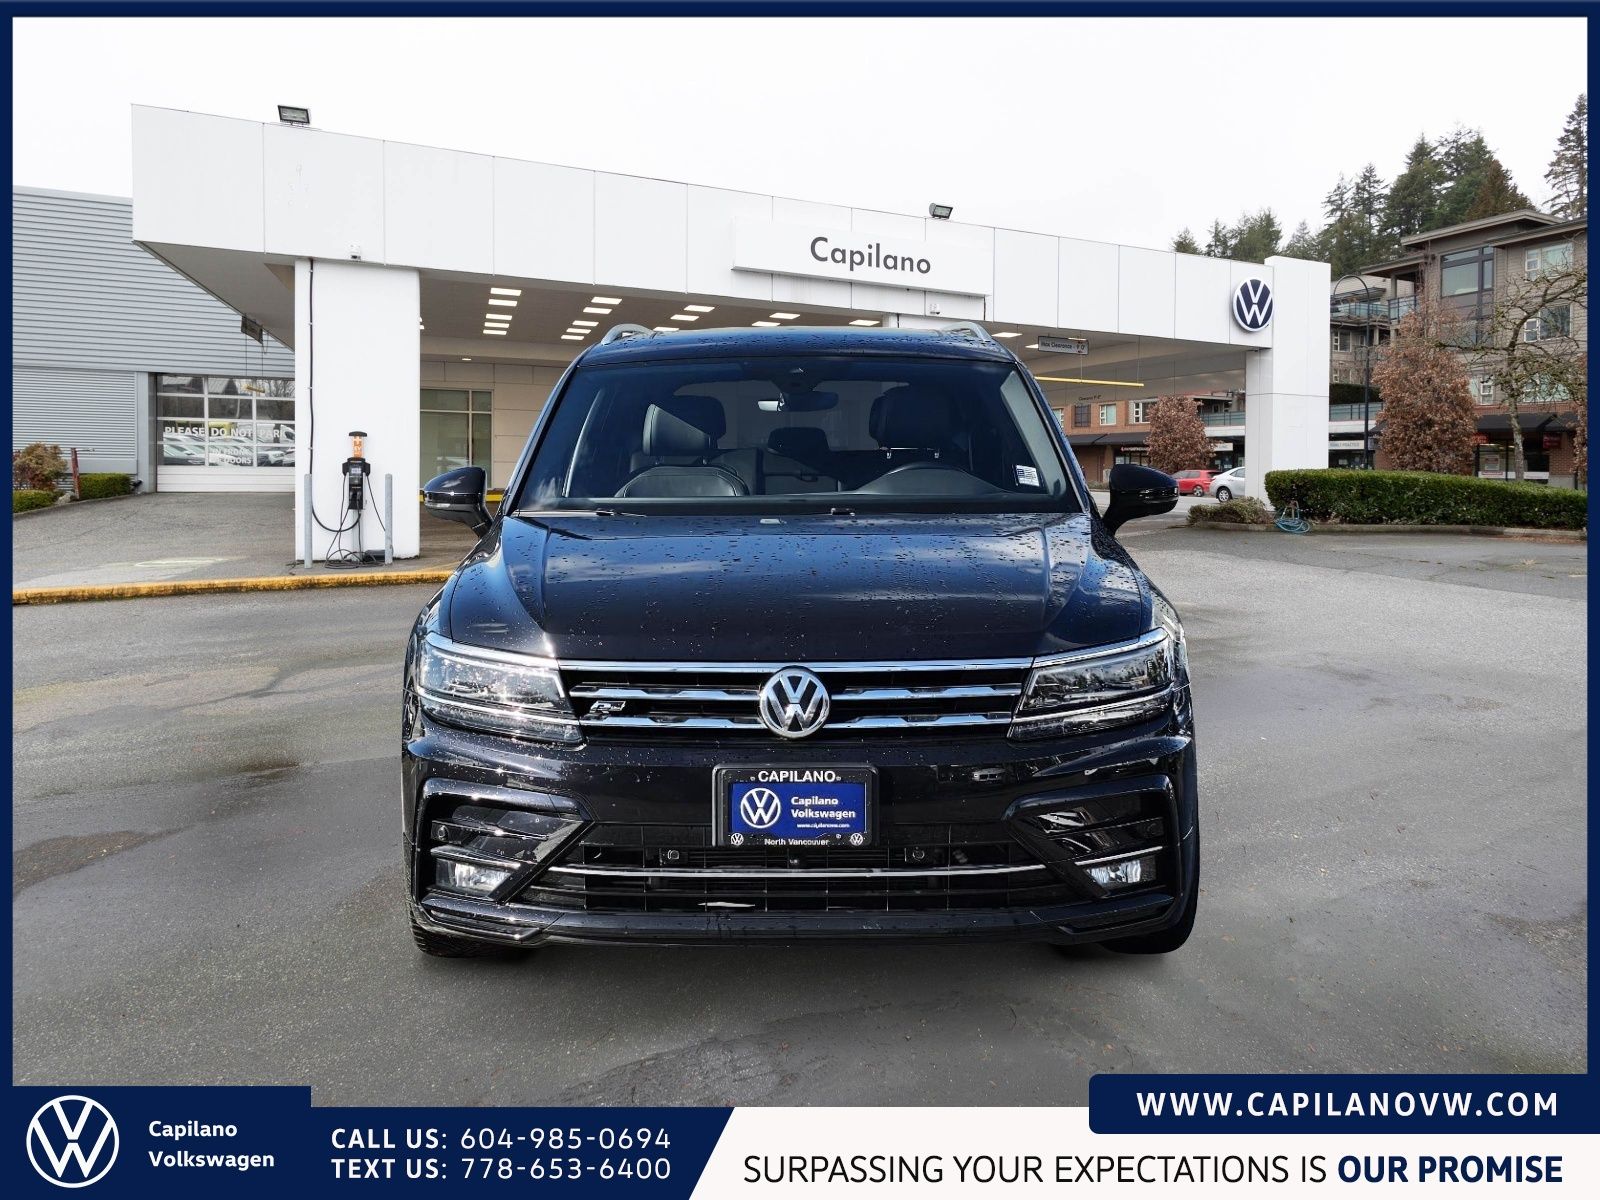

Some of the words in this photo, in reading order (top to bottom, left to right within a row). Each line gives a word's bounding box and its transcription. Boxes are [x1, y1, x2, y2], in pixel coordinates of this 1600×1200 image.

[810, 236, 931, 275] Capilano
[165, 426, 205, 437] PLEASE
[211, 428, 226, 437] DO
[231, 429, 253, 438] NOT
[225, 457, 252, 465] DOORS
[757, 770, 836, 783] CAPILANO
[791, 796, 839, 807] Capilano
[741, 788, 781, 828] VW
[791, 809, 856, 820] Volkswagen
[764, 838, 787, 846] North
[788, 838, 830, 846] Vancouver
